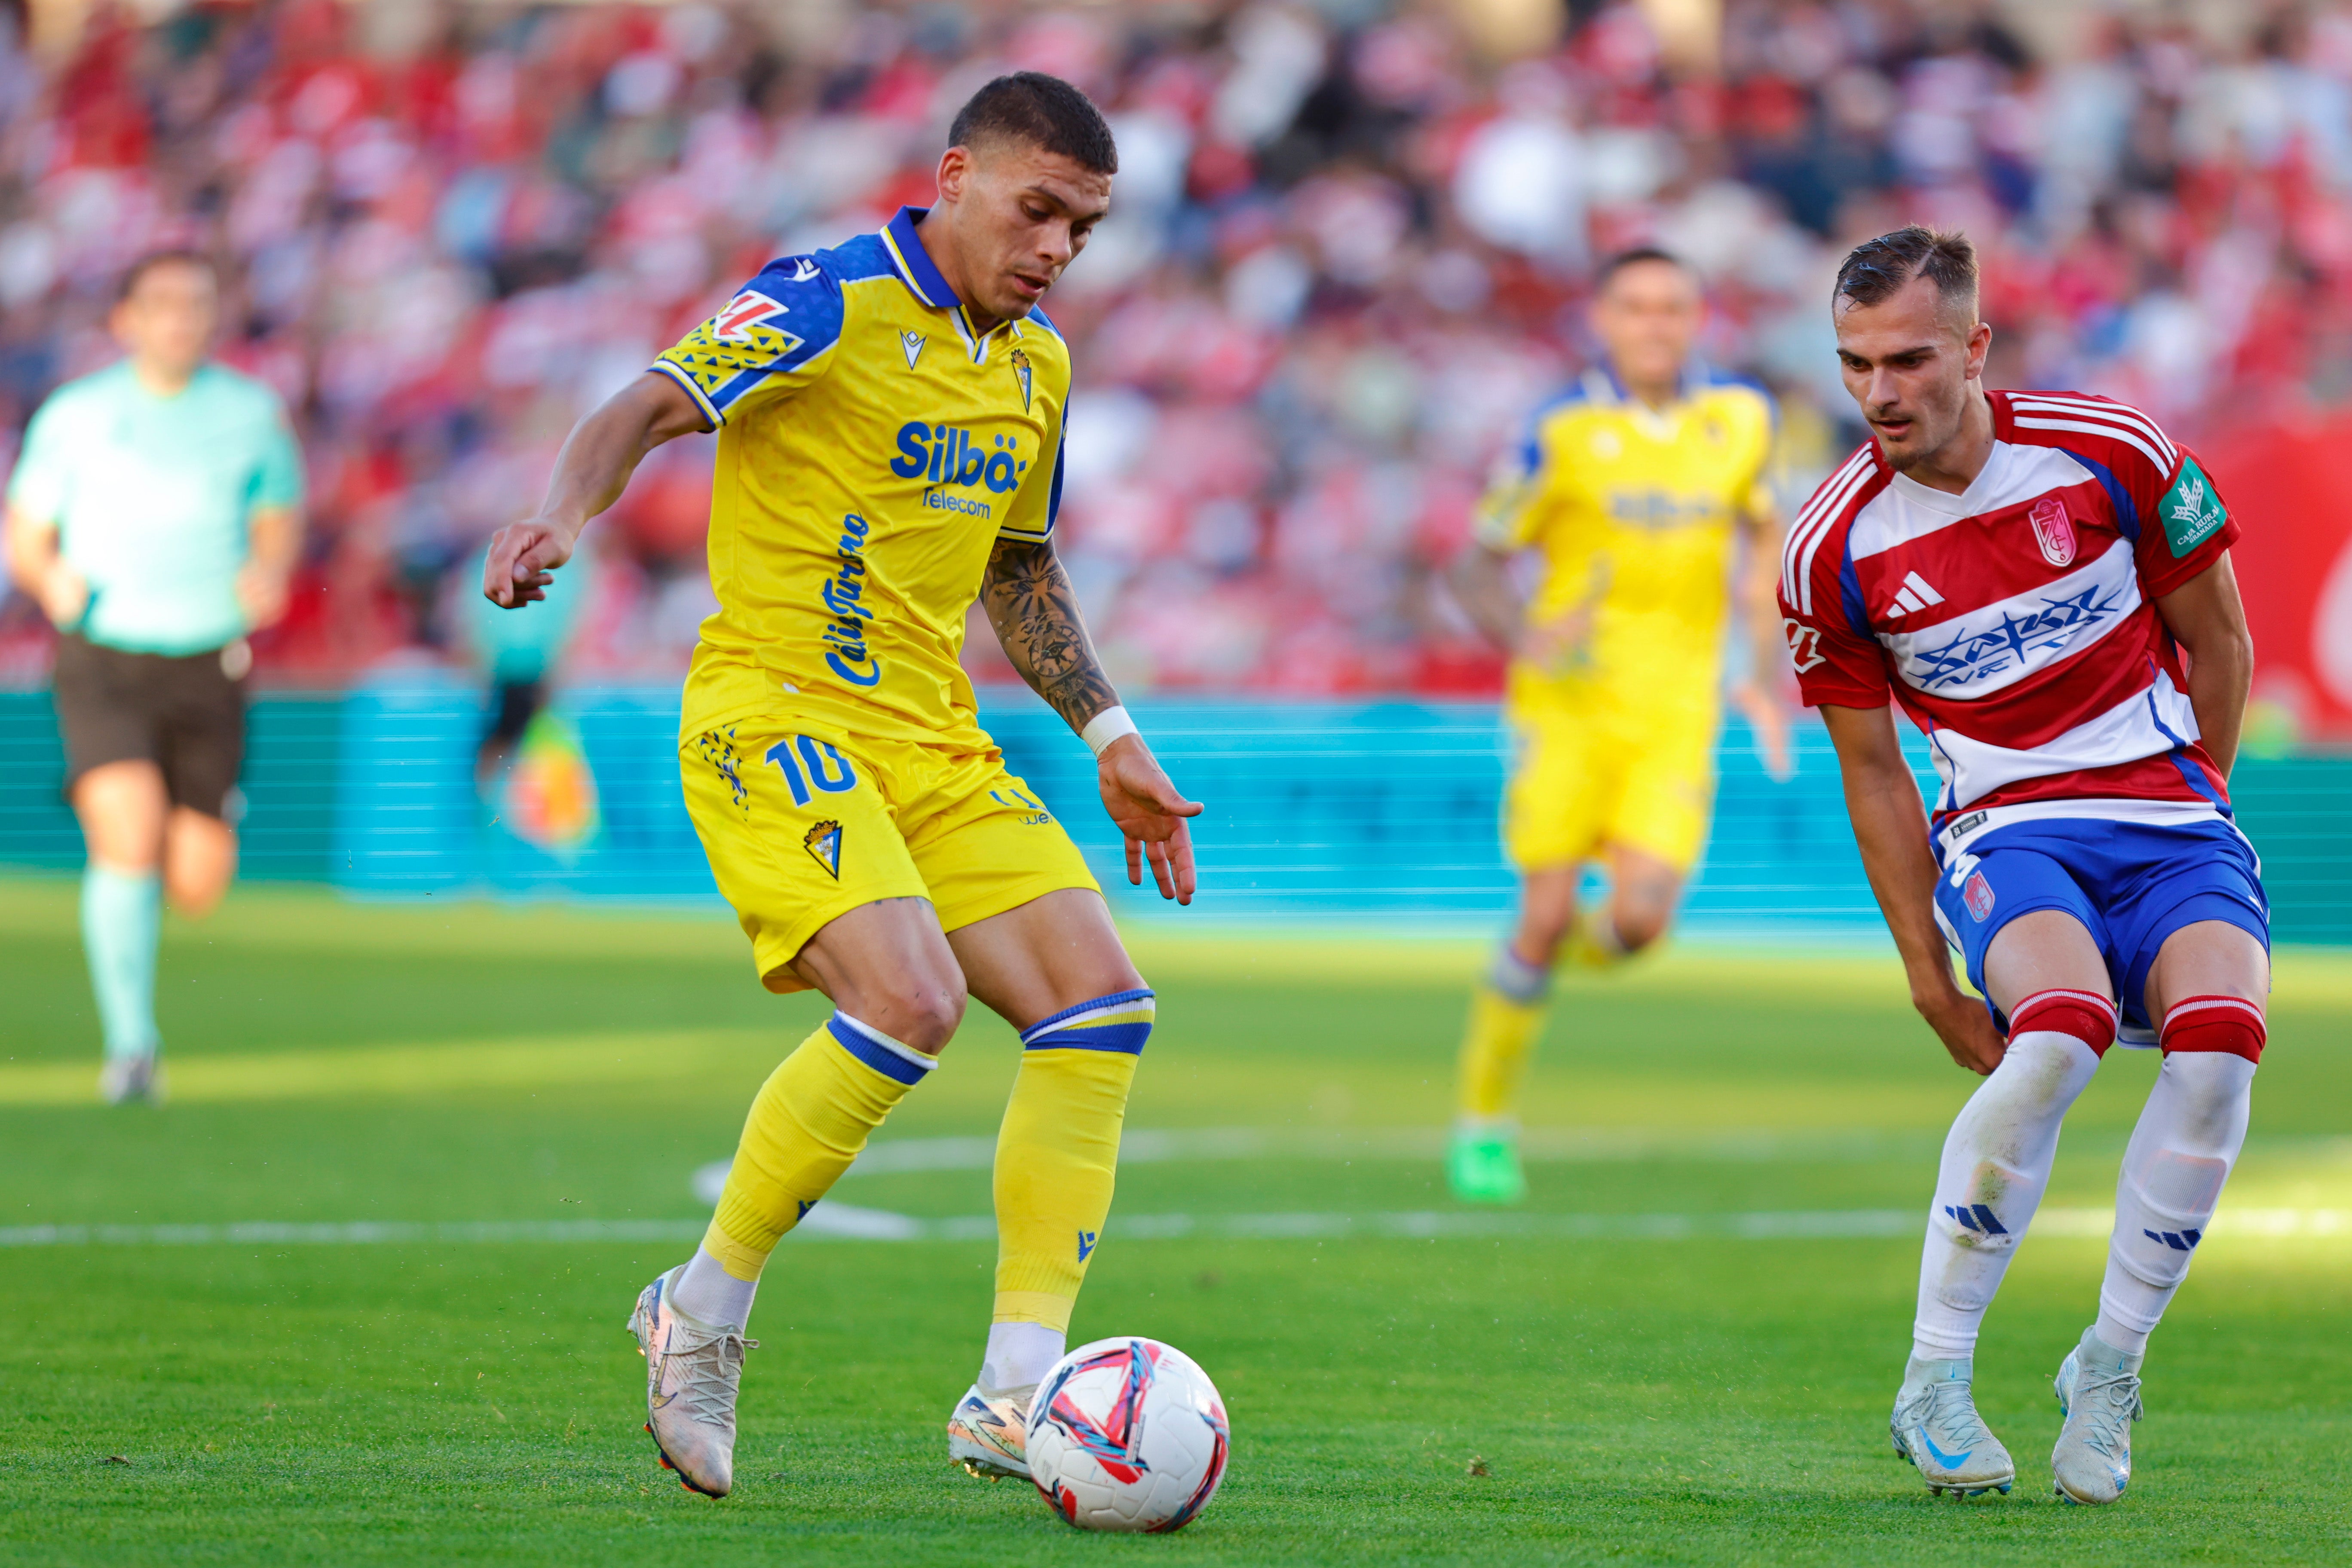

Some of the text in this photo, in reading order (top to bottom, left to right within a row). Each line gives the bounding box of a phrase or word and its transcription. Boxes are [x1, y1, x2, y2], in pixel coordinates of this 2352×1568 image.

[922, 487, 991, 520] Telecom
[2177, 505, 2219, 545] CAJA RURAL
[2189, 519, 2218, 543] GRANADA
[765, 734, 858, 808] 10
